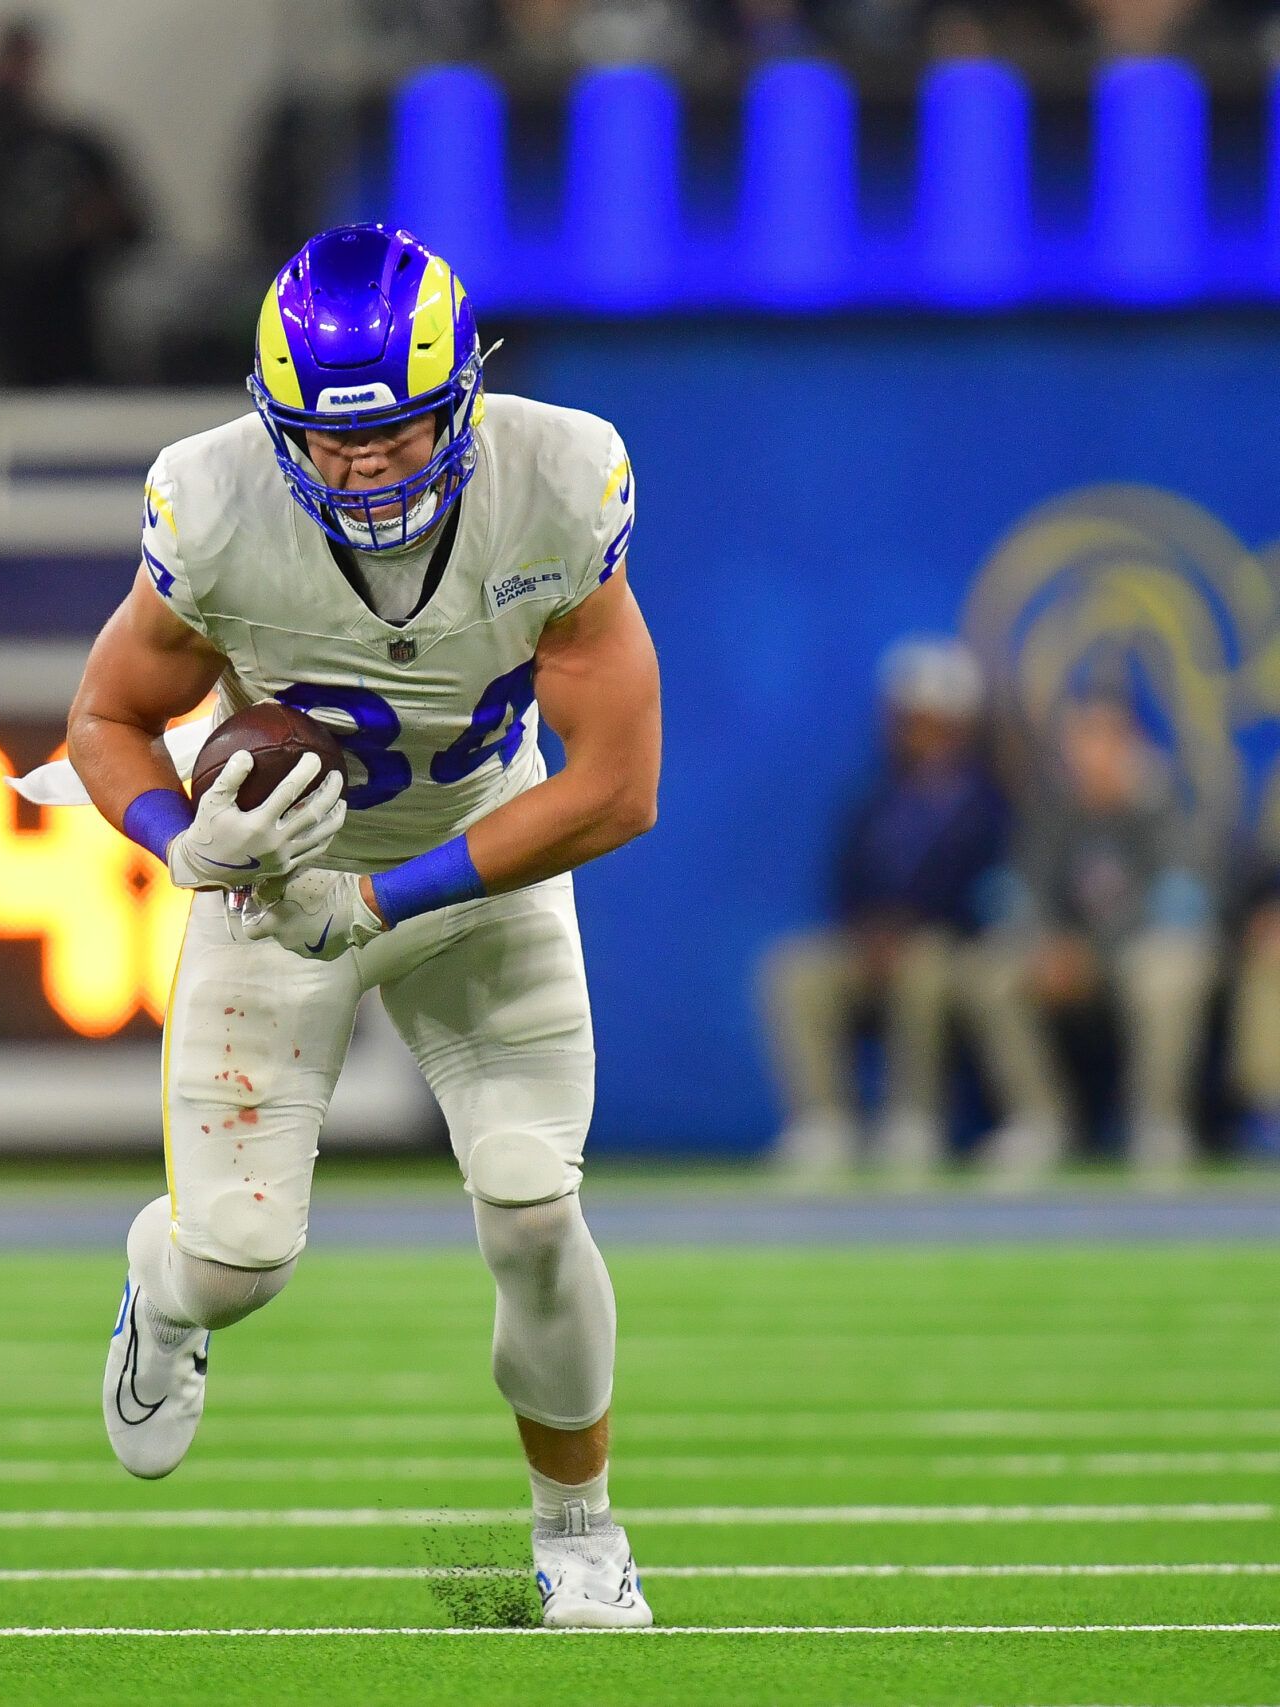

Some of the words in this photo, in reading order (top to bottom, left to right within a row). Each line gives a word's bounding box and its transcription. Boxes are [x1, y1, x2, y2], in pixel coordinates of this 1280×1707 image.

[330, 391, 376, 405] RAMS
[493, 574, 521, 592] LOS
[496, 573, 562, 600] ANGELES
[497, 584, 537, 607] RAMS
